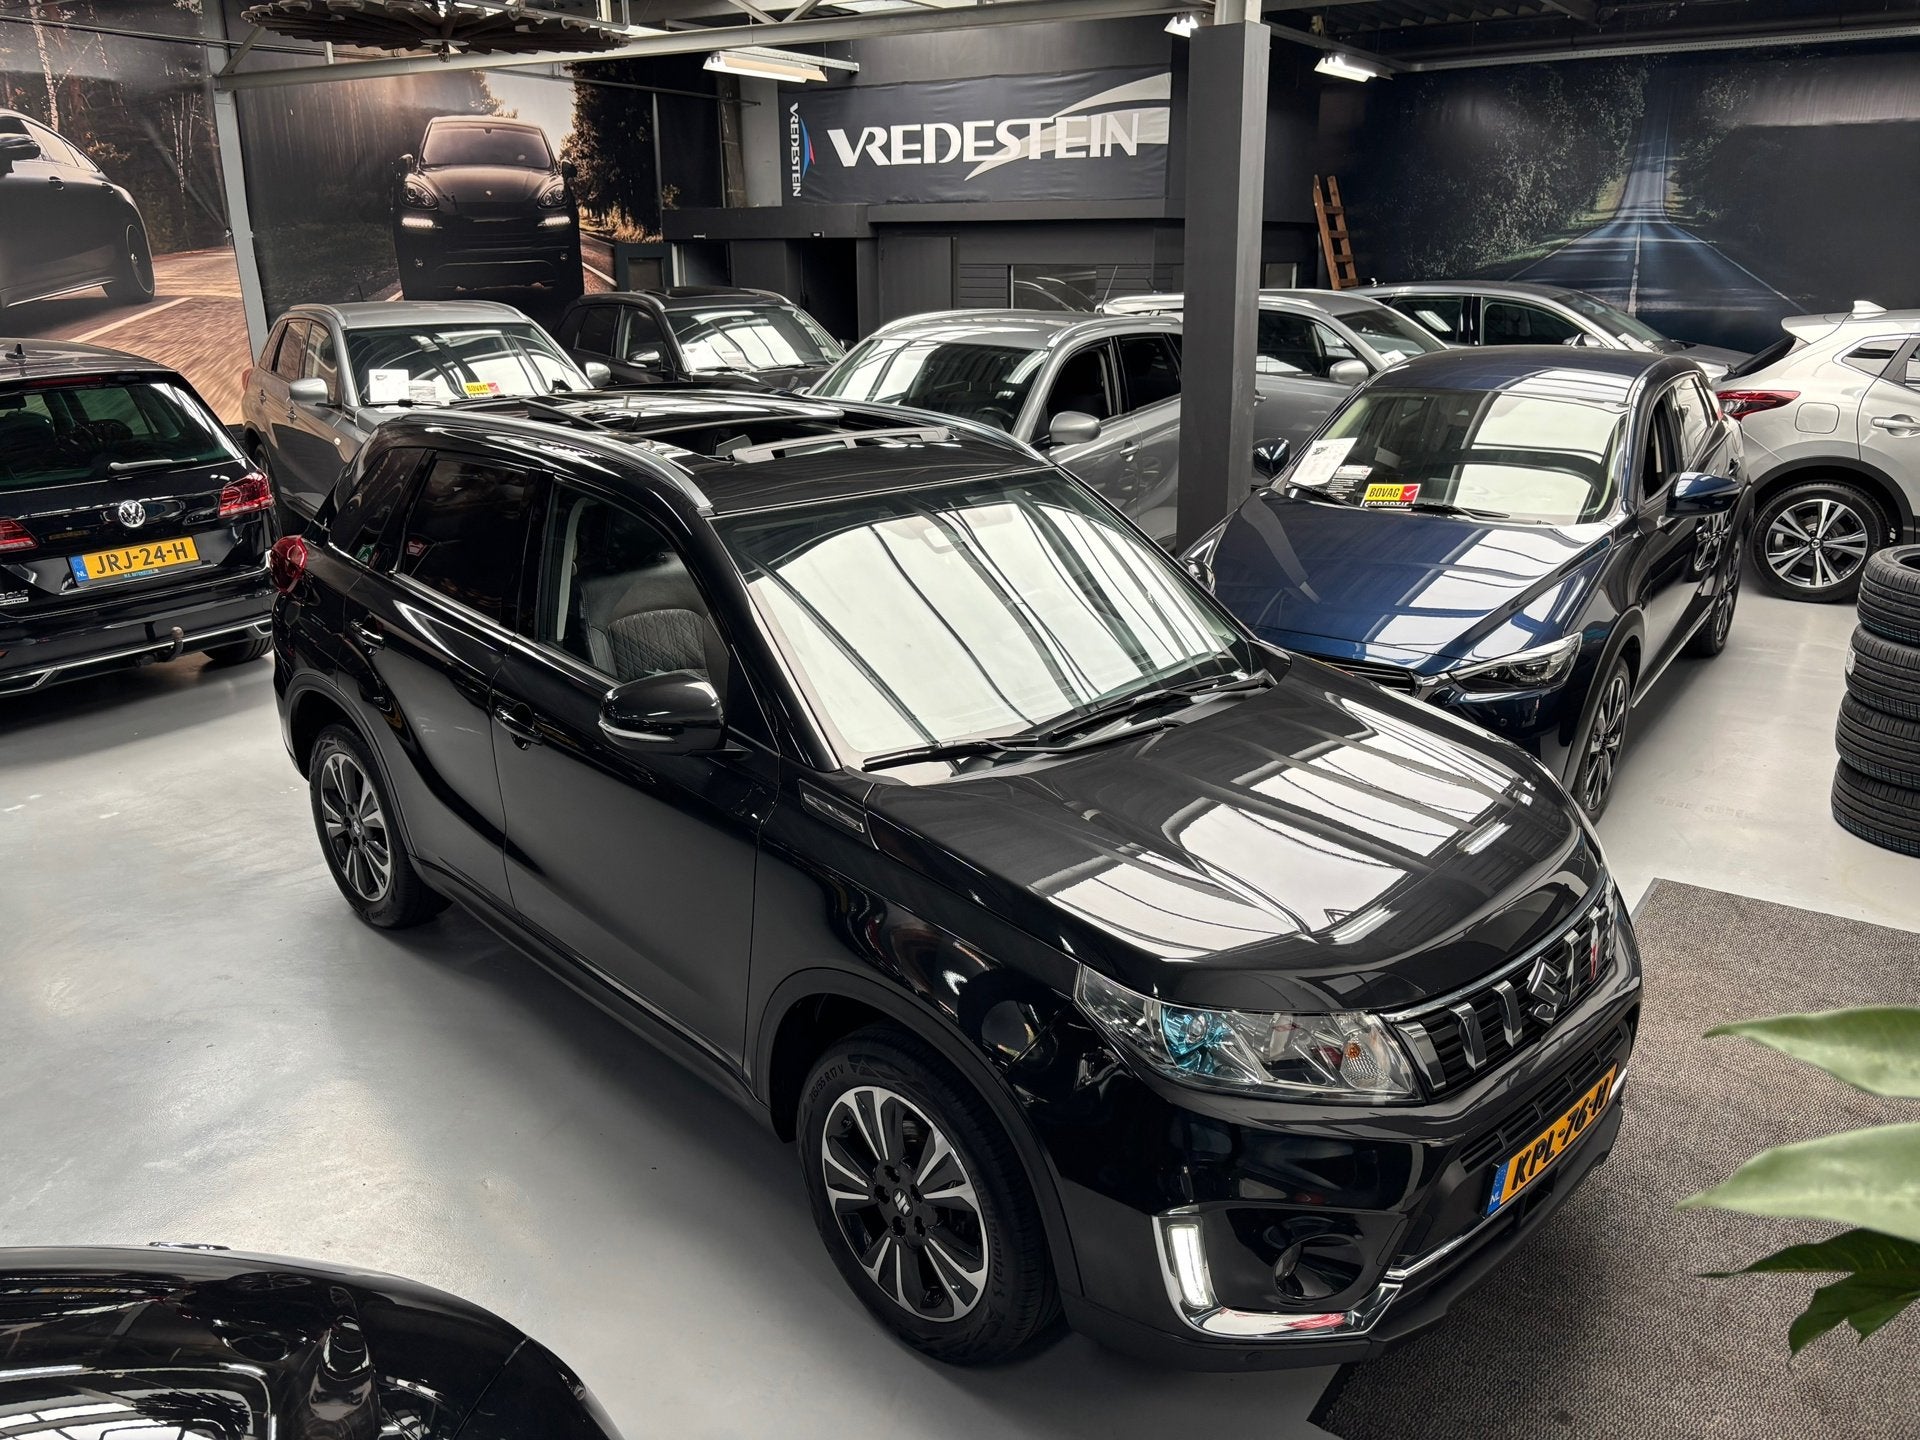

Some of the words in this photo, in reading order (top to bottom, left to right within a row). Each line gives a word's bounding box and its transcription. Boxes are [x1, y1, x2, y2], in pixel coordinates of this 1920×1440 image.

[789, 102, 802, 197] VREDESTEIN
[827, 113, 1140, 168] VREDESTEIN
[1369, 487, 1401, 498] BOVAG
[76, 570, 87, 578] NL
[97, 542, 189, 575] JRJ-24-H
[1511, 1076, 1611, 1190] KPL-76-H
